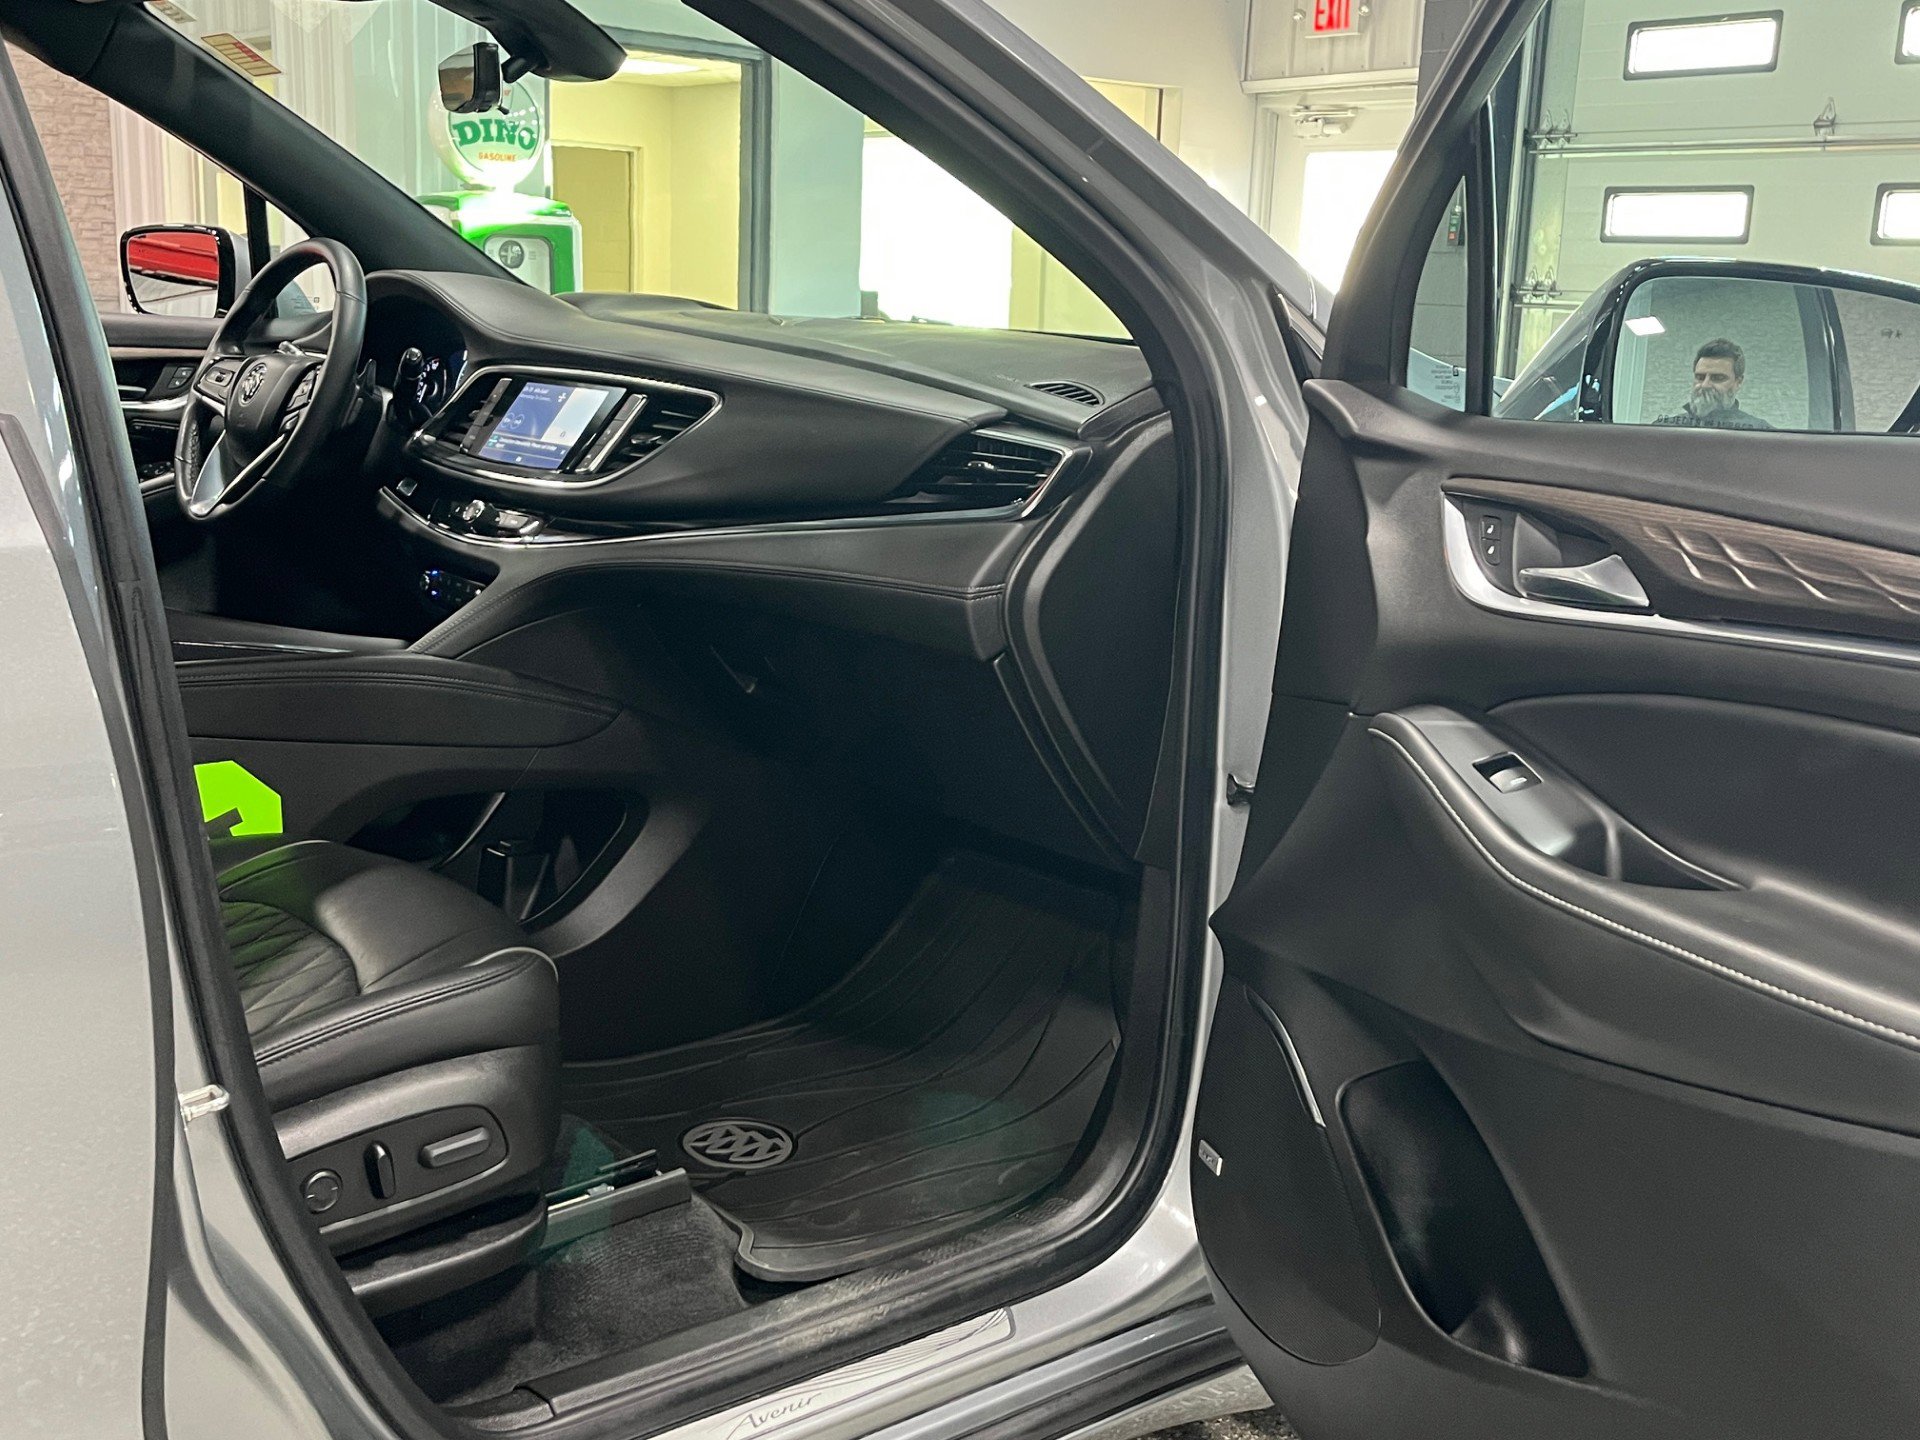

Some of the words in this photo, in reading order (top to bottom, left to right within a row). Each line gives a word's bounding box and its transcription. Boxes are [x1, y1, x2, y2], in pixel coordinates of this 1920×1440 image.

[452, 118, 537, 151] DINO
[478, 151, 517, 162] GASOLINE
[727, 1392, 822, 1440] Avenir
